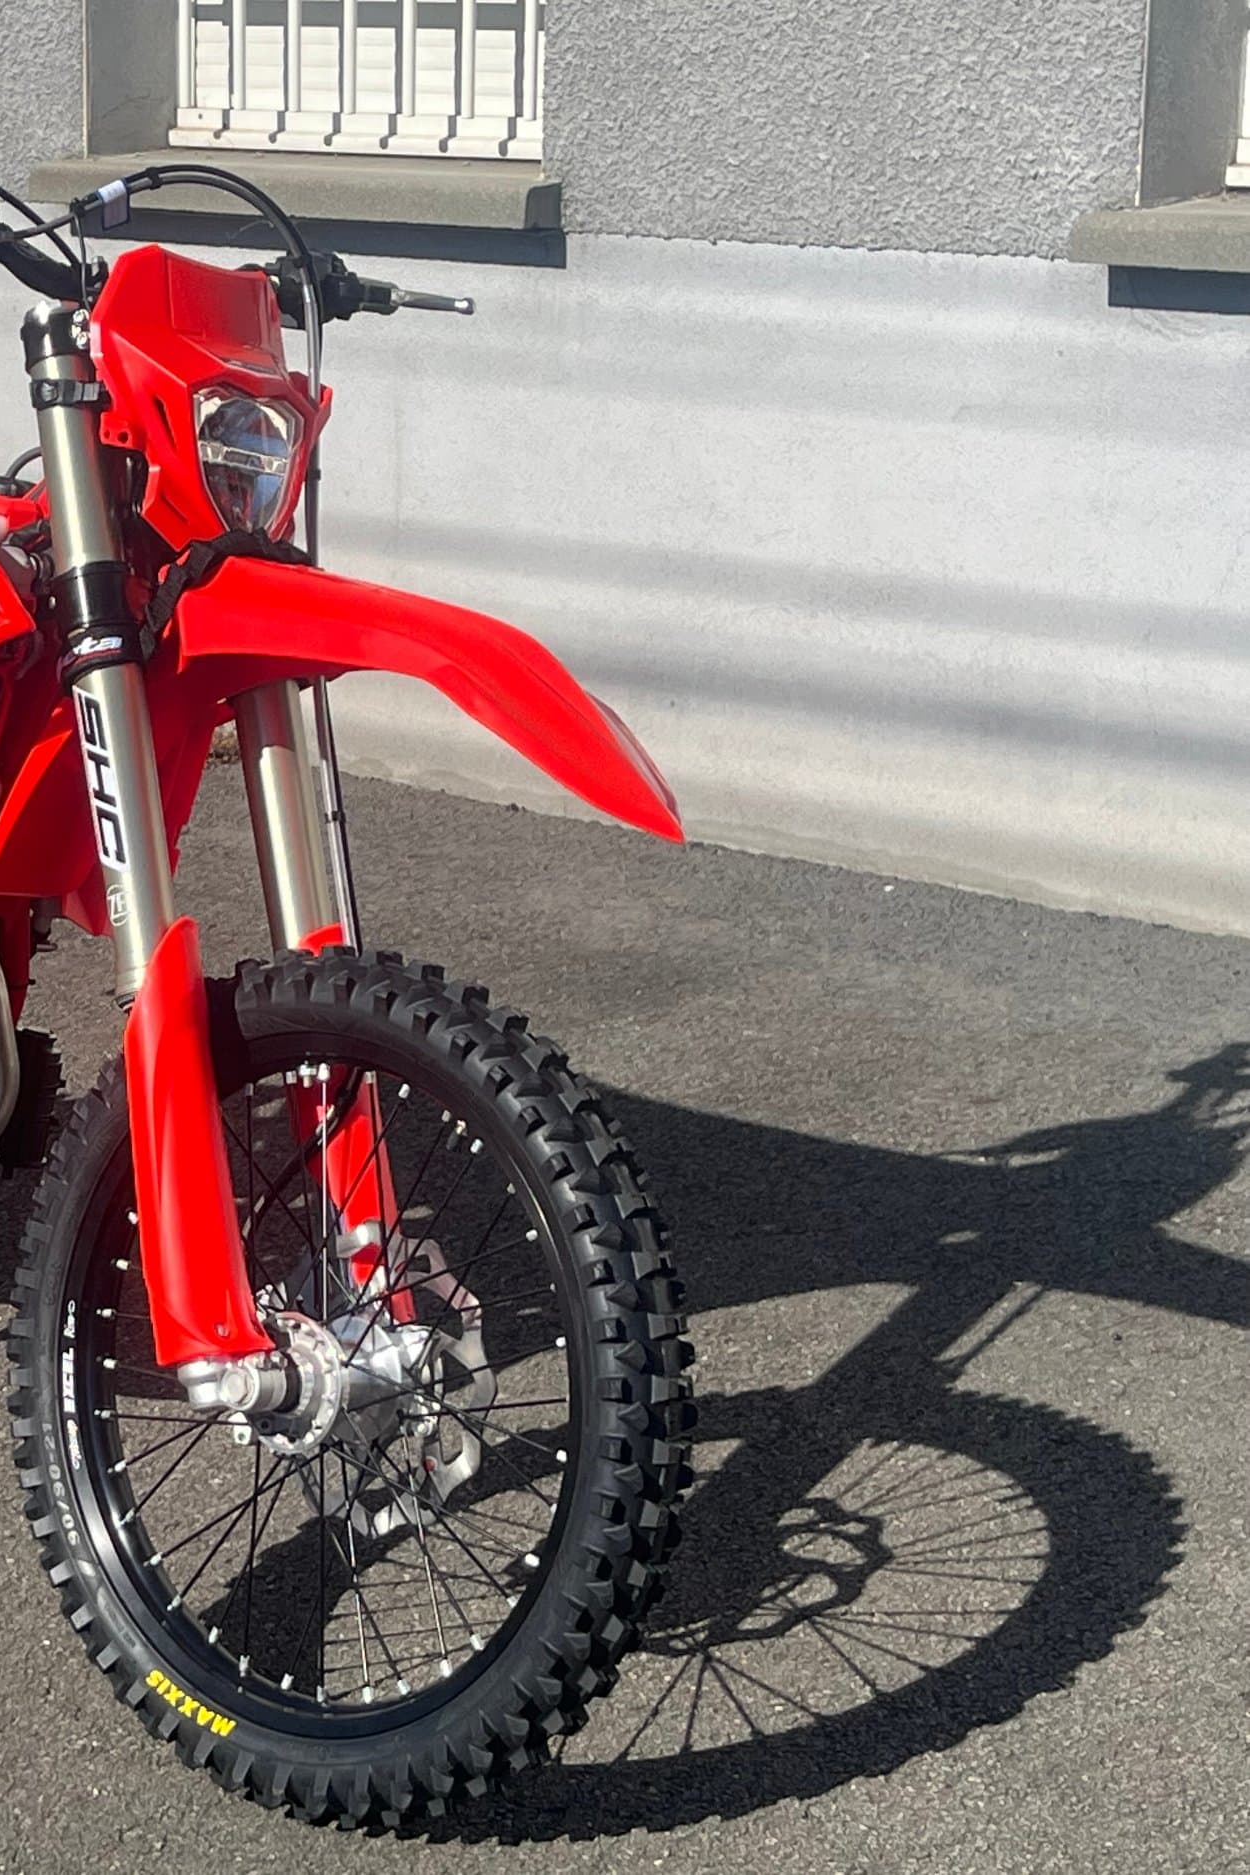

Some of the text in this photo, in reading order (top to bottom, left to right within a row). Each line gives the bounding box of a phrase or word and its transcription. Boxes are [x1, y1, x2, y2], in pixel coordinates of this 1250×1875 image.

[62, 1347, 76, 1413] EXCEL
[42, 1423, 81, 1546] 90/90-21
[145, 1669, 238, 1737] MAXXIS
